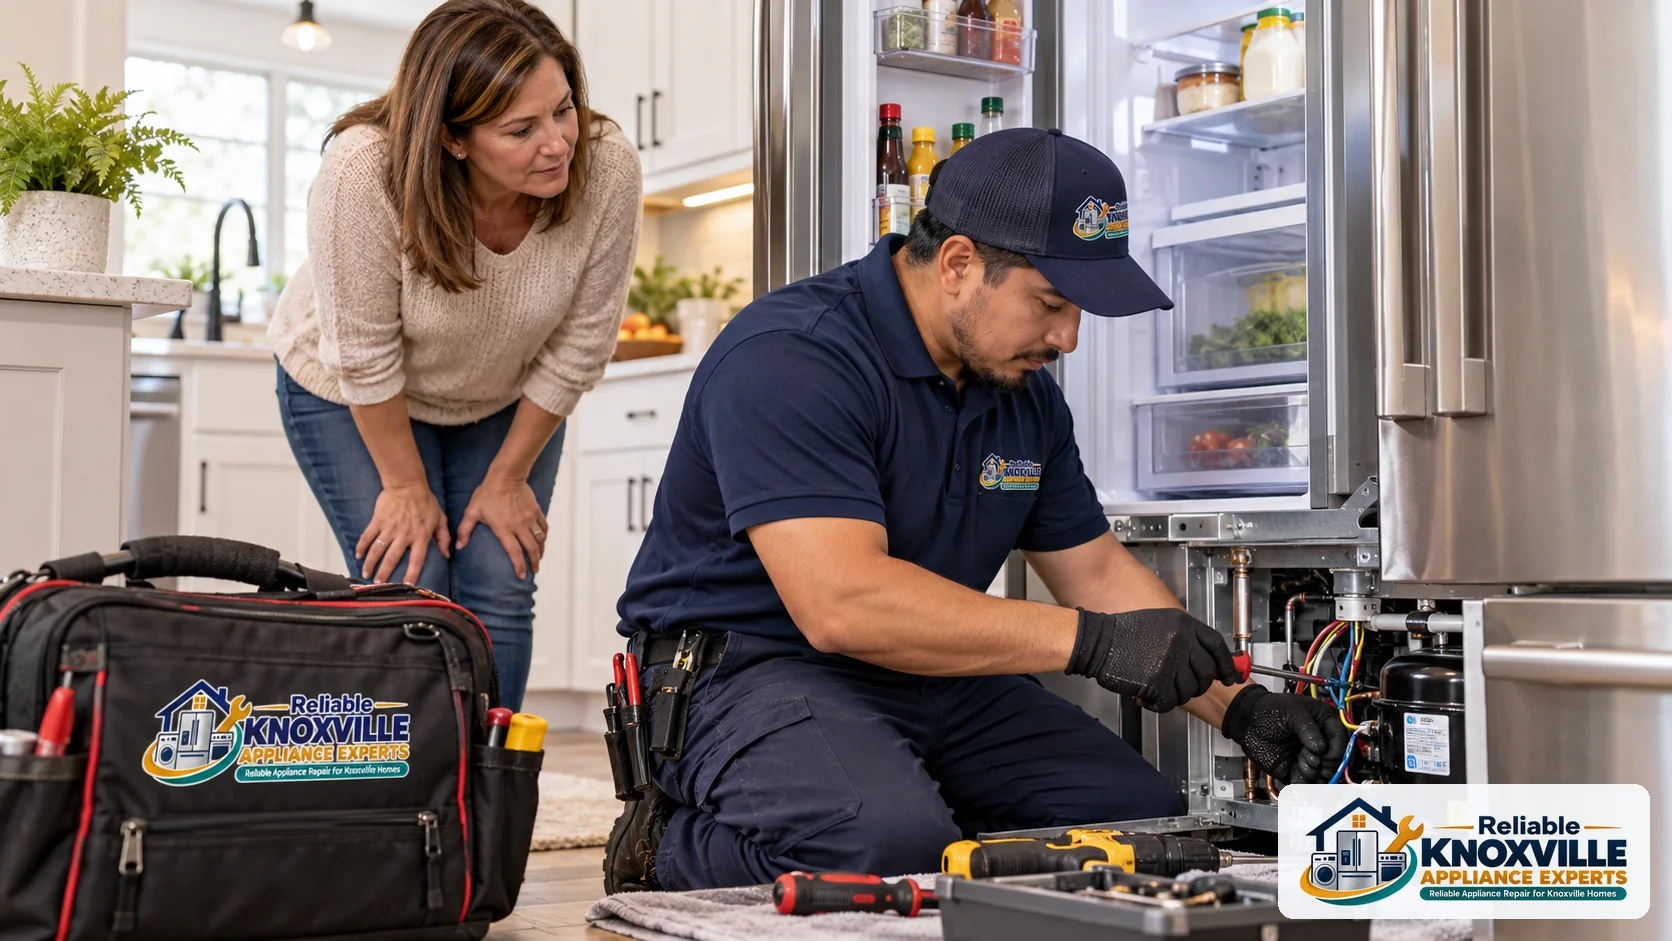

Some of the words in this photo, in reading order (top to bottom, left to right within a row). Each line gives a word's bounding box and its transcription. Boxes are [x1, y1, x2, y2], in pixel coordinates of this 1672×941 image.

[289, 693, 374, 714] Reliable
[243, 714, 410, 745] KNOXVILLE
[237, 745, 334, 765] APPLIANCE
[337, 743, 410, 761] EXPERTS
[273, 767, 307, 779] Appliance
[332, 766, 343, 775] for
[377, 765, 400, 774] Homes
